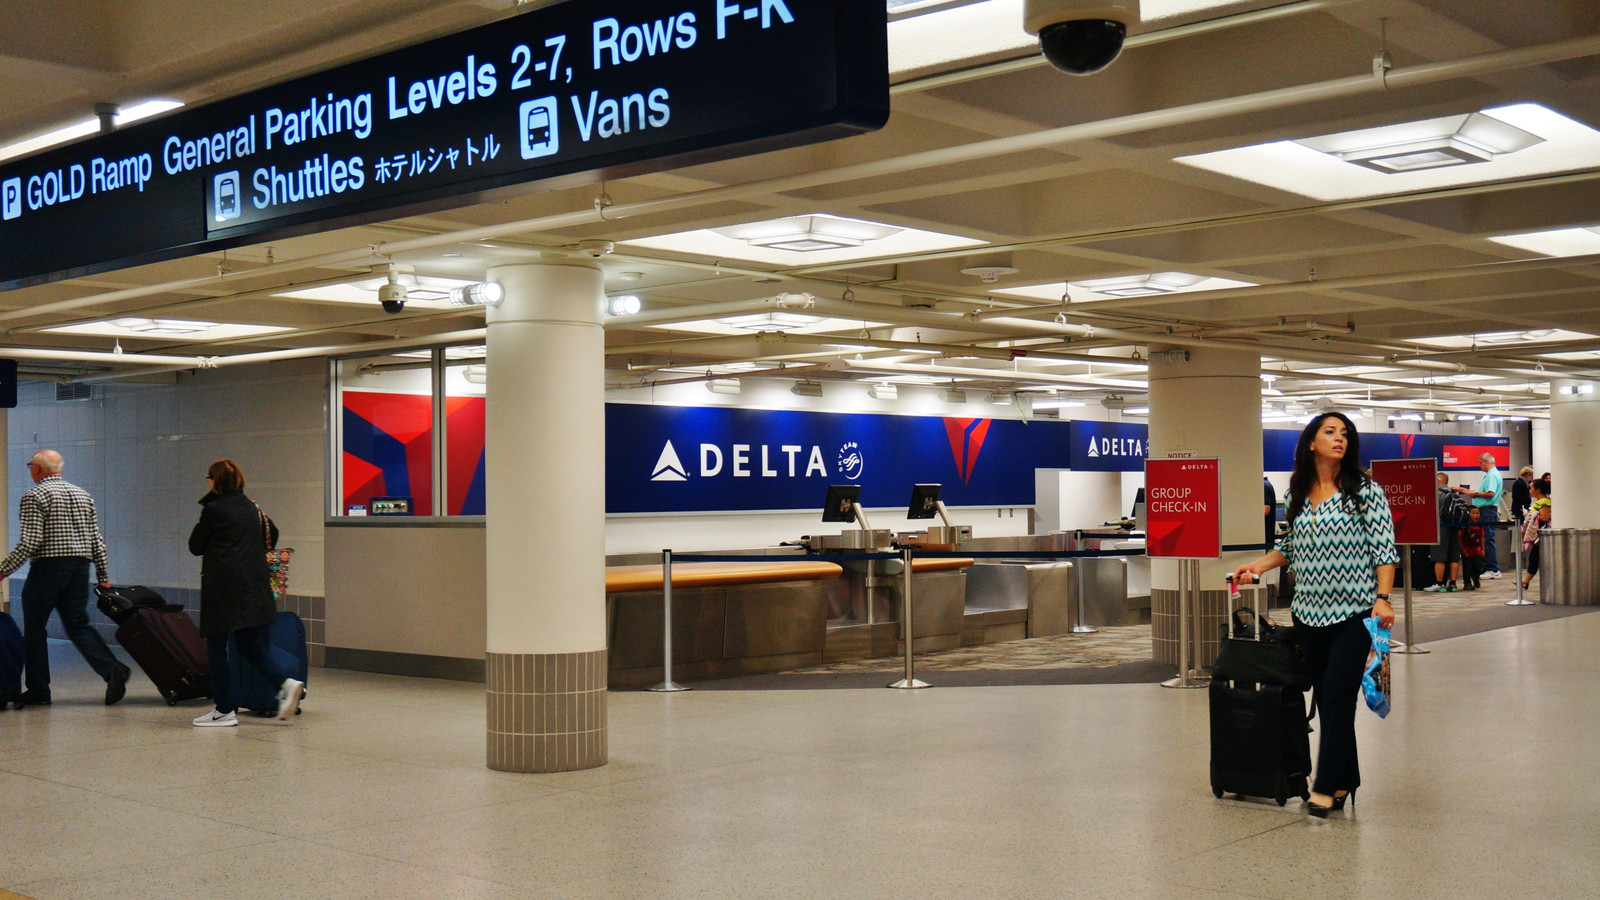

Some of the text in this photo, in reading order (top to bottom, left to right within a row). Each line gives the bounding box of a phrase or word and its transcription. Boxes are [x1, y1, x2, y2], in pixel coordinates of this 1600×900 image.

[27, 168, 86, 211] GOLD
[91, 152, 153, 194] Ramp
[163, 114, 256, 175] General
[265, 92, 372, 150] Parking
[388, 58, 498, 120] Levels
[511, 38, 572, 90] 2-7,
[593, 11, 697, 70] Rows
[570, 86, 670, 142] Vans
[374, 133, 501, 184] ホテルシャトル
[252, 153, 365, 211] Shuttles
[699, 443, 828, 478] DELTA
[1101, 437, 1143, 457] DELTA
[1151, 487, 1192, 499] GROUP
[1381, 484, 1412, 494] ROUP
[1387, 495, 1426, 506] HECK-IN
[1151, 501, 1207, 513] CHECK-IN
